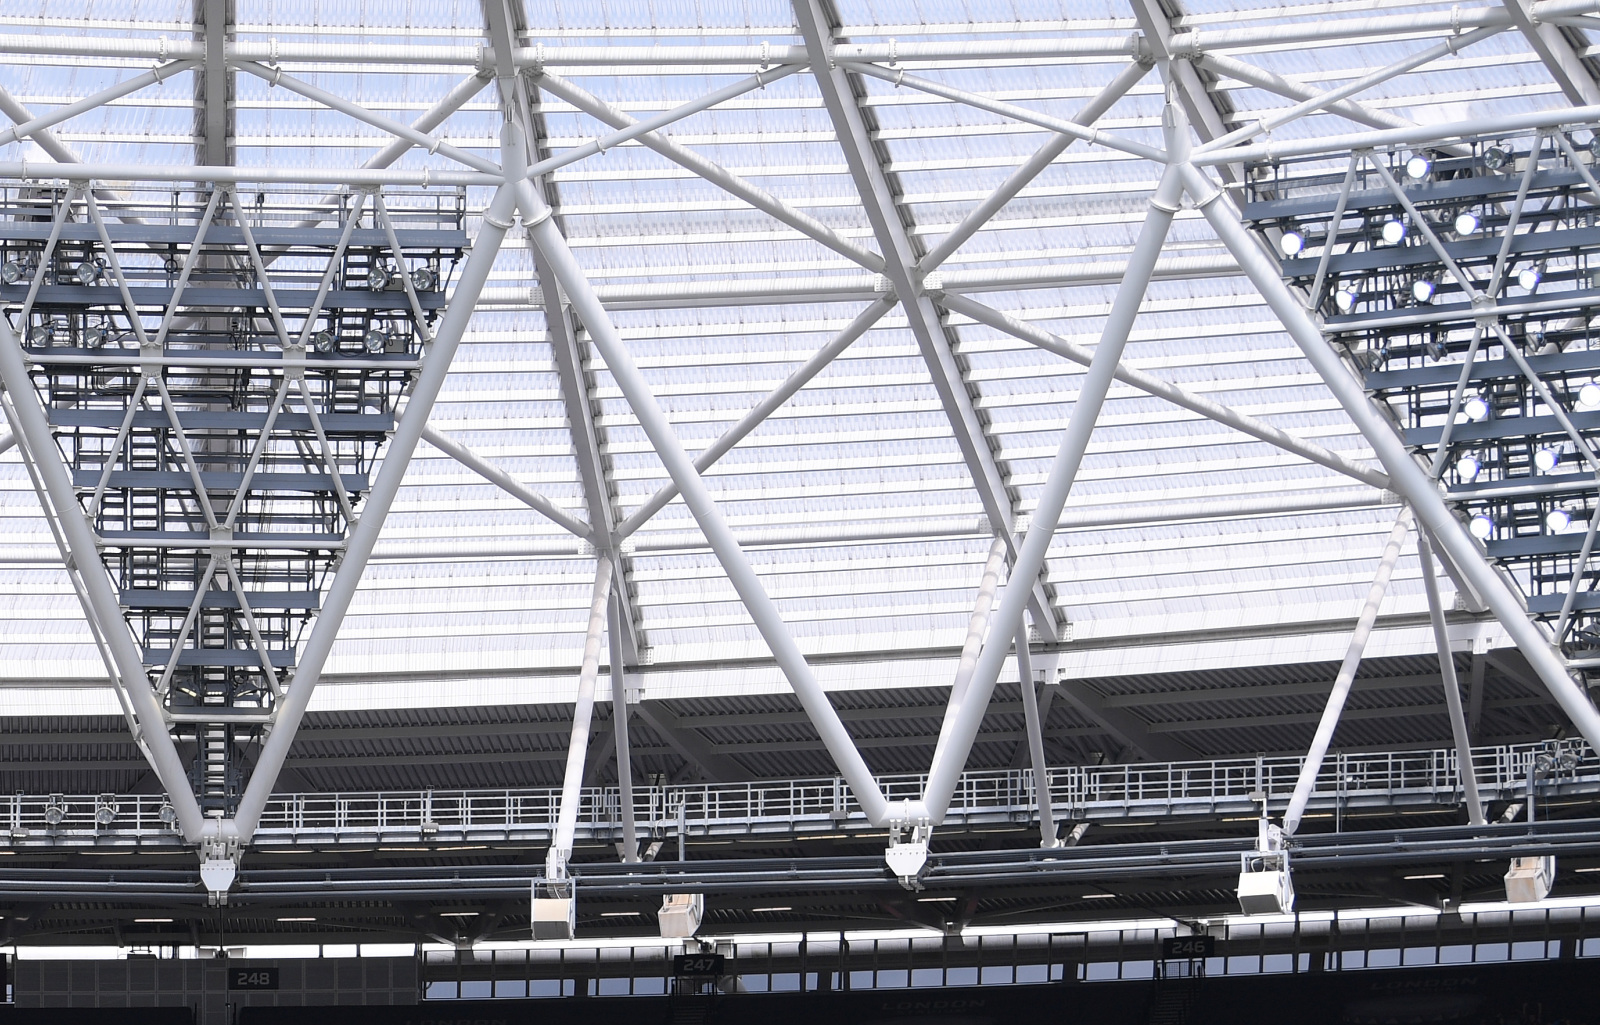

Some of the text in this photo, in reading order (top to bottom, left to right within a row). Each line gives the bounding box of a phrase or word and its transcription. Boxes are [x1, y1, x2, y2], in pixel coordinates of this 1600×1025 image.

[1171, 940, 1206, 954] 246
[683, 958, 715, 971] 247
[237, 971, 270, 985] 248
[1370, 977, 1479, 990] LONDON
[882, 999, 986, 1011] LONDON
